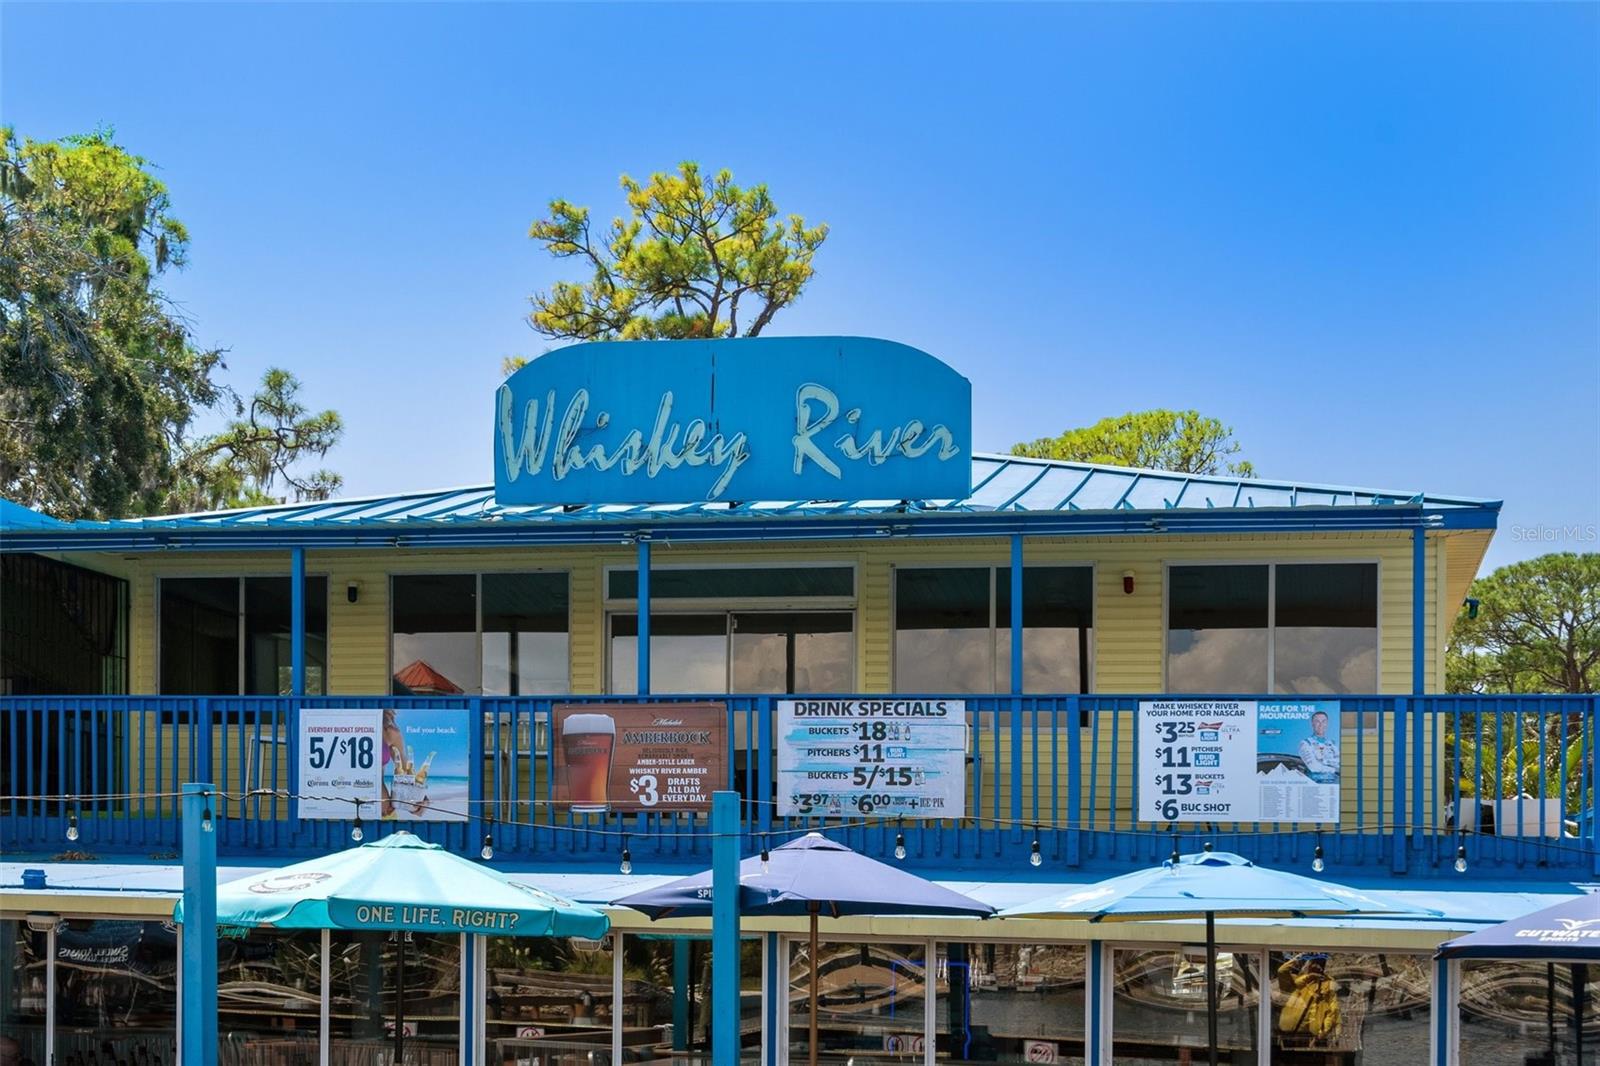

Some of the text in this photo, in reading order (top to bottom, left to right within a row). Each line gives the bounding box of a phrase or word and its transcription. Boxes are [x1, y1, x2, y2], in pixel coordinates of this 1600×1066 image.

[498, 382, 960, 501] Whiskey River
[794, 701, 947, 717] DRINK SPECIALS
[1146, 709, 1246, 717] YOUR HOME FOR NASCAR
[1259, 705, 1315, 713] RACE FOR THE
[1259, 712, 1310, 720] MOUNTAINS
[334, 726, 354, 734] BUCKET
[354, 726, 375, 734] SPECIAL
[406, 725, 421, 734] Find
[421, 727, 436, 736] your
[808, 721, 887, 741] BUCKETS $18
[309, 735, 374, 769] 5/$18
[807, 744, 885, 763] PITCHERS $11
[1155, 746, 1191, 768] $11
[1195, 759, 1218, 767] LIGHT
[629, 767, 708, 775] WHISKEY RIVER AMBER
[807, 765, 913, 789] BUCKETS 5/$15
[667, 777, 701, 786] DRAFTS
[1155, 774, 1192, 795] $13
[629, 775, 659, 807] $3
[667, 786, 701, 794] ALL DAY
[662, 794, 707, 803] EVERY DAY
[1155, 799, 1179, 820] $6
[1181, 803, 1201, 812] BUC
[1203, 803, 1231, 812] SHOT
[697, 888, 714, 899] SPI
[356, 906, 395, 924] ONE
[452, 909, 520, 930] RIGHT?
